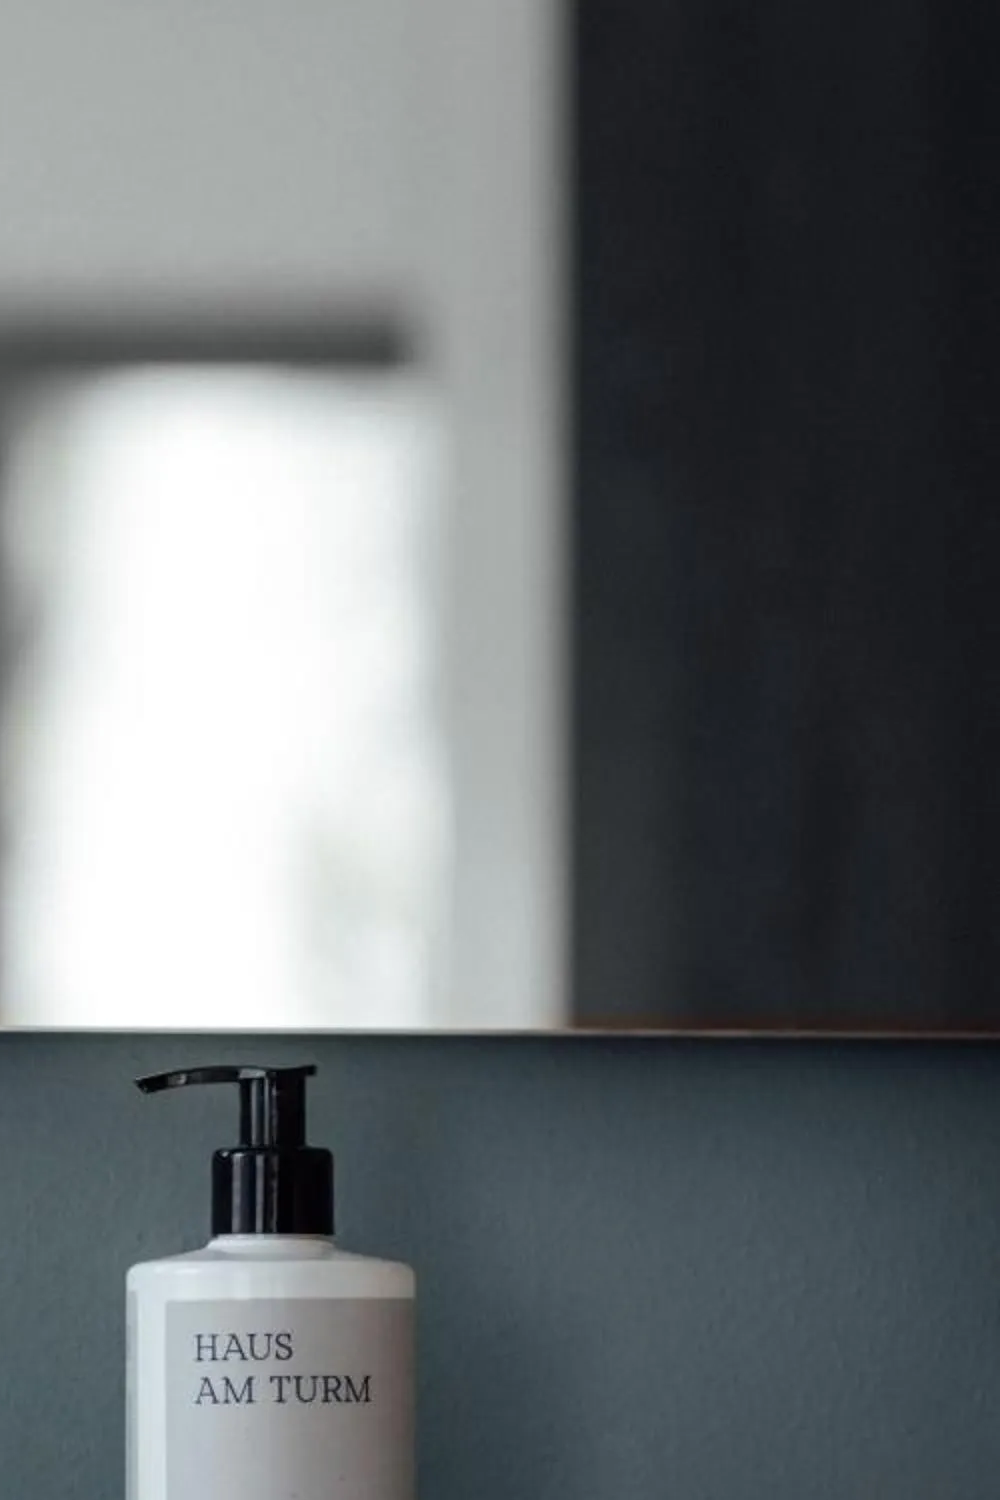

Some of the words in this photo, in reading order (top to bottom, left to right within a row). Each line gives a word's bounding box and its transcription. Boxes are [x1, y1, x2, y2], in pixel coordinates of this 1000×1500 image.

[194, 1333, 294, 1361] HAUS
[194, 1376, 255, 1404] AM
[269, 1375, 373, 1404] TURM
